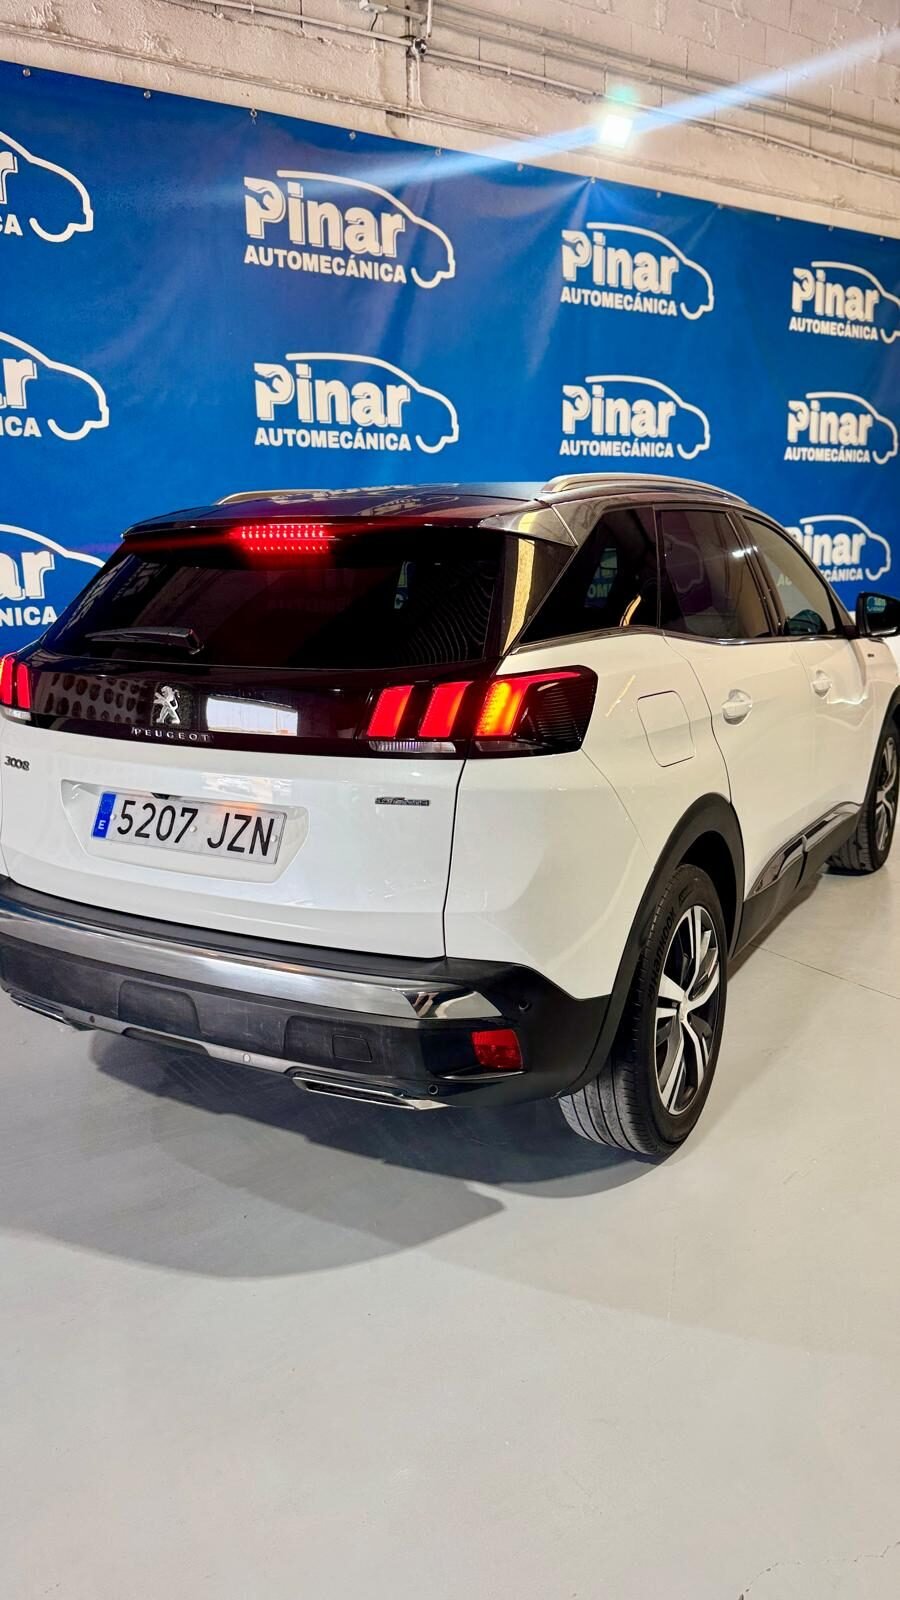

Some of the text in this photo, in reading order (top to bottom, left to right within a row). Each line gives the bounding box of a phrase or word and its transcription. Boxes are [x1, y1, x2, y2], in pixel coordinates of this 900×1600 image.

[243, 176, 406, 259] Pinar
[243, 244, 408, 285] AUTOMECÁNICA
[561, 229, 679, 296] Pinar
[560, 286, 678, 317] AUTOMECÁNICA
[791, 267, 880, 323] Pinar
[789, 316, 879, 341] AUTOMECÁNICA
[253, 362, 411, 428] Pinar
[562, 384, 676, 439] Pinar
[254, 427, 412, 452] AUTOMECÁNICA
[787, 400, 873, 446] Pinar
[559, 437, 674, 459] AUTOMECÁNICA
[784, 446, 871, 464] AUTOMECÁNICA
[131, 726, 212, 743] PEUGEOT
[4, 755, 30, 772] 3008
[98, 820, 106, 830] E
[117, 799, 275, 856] 5207 JZN
